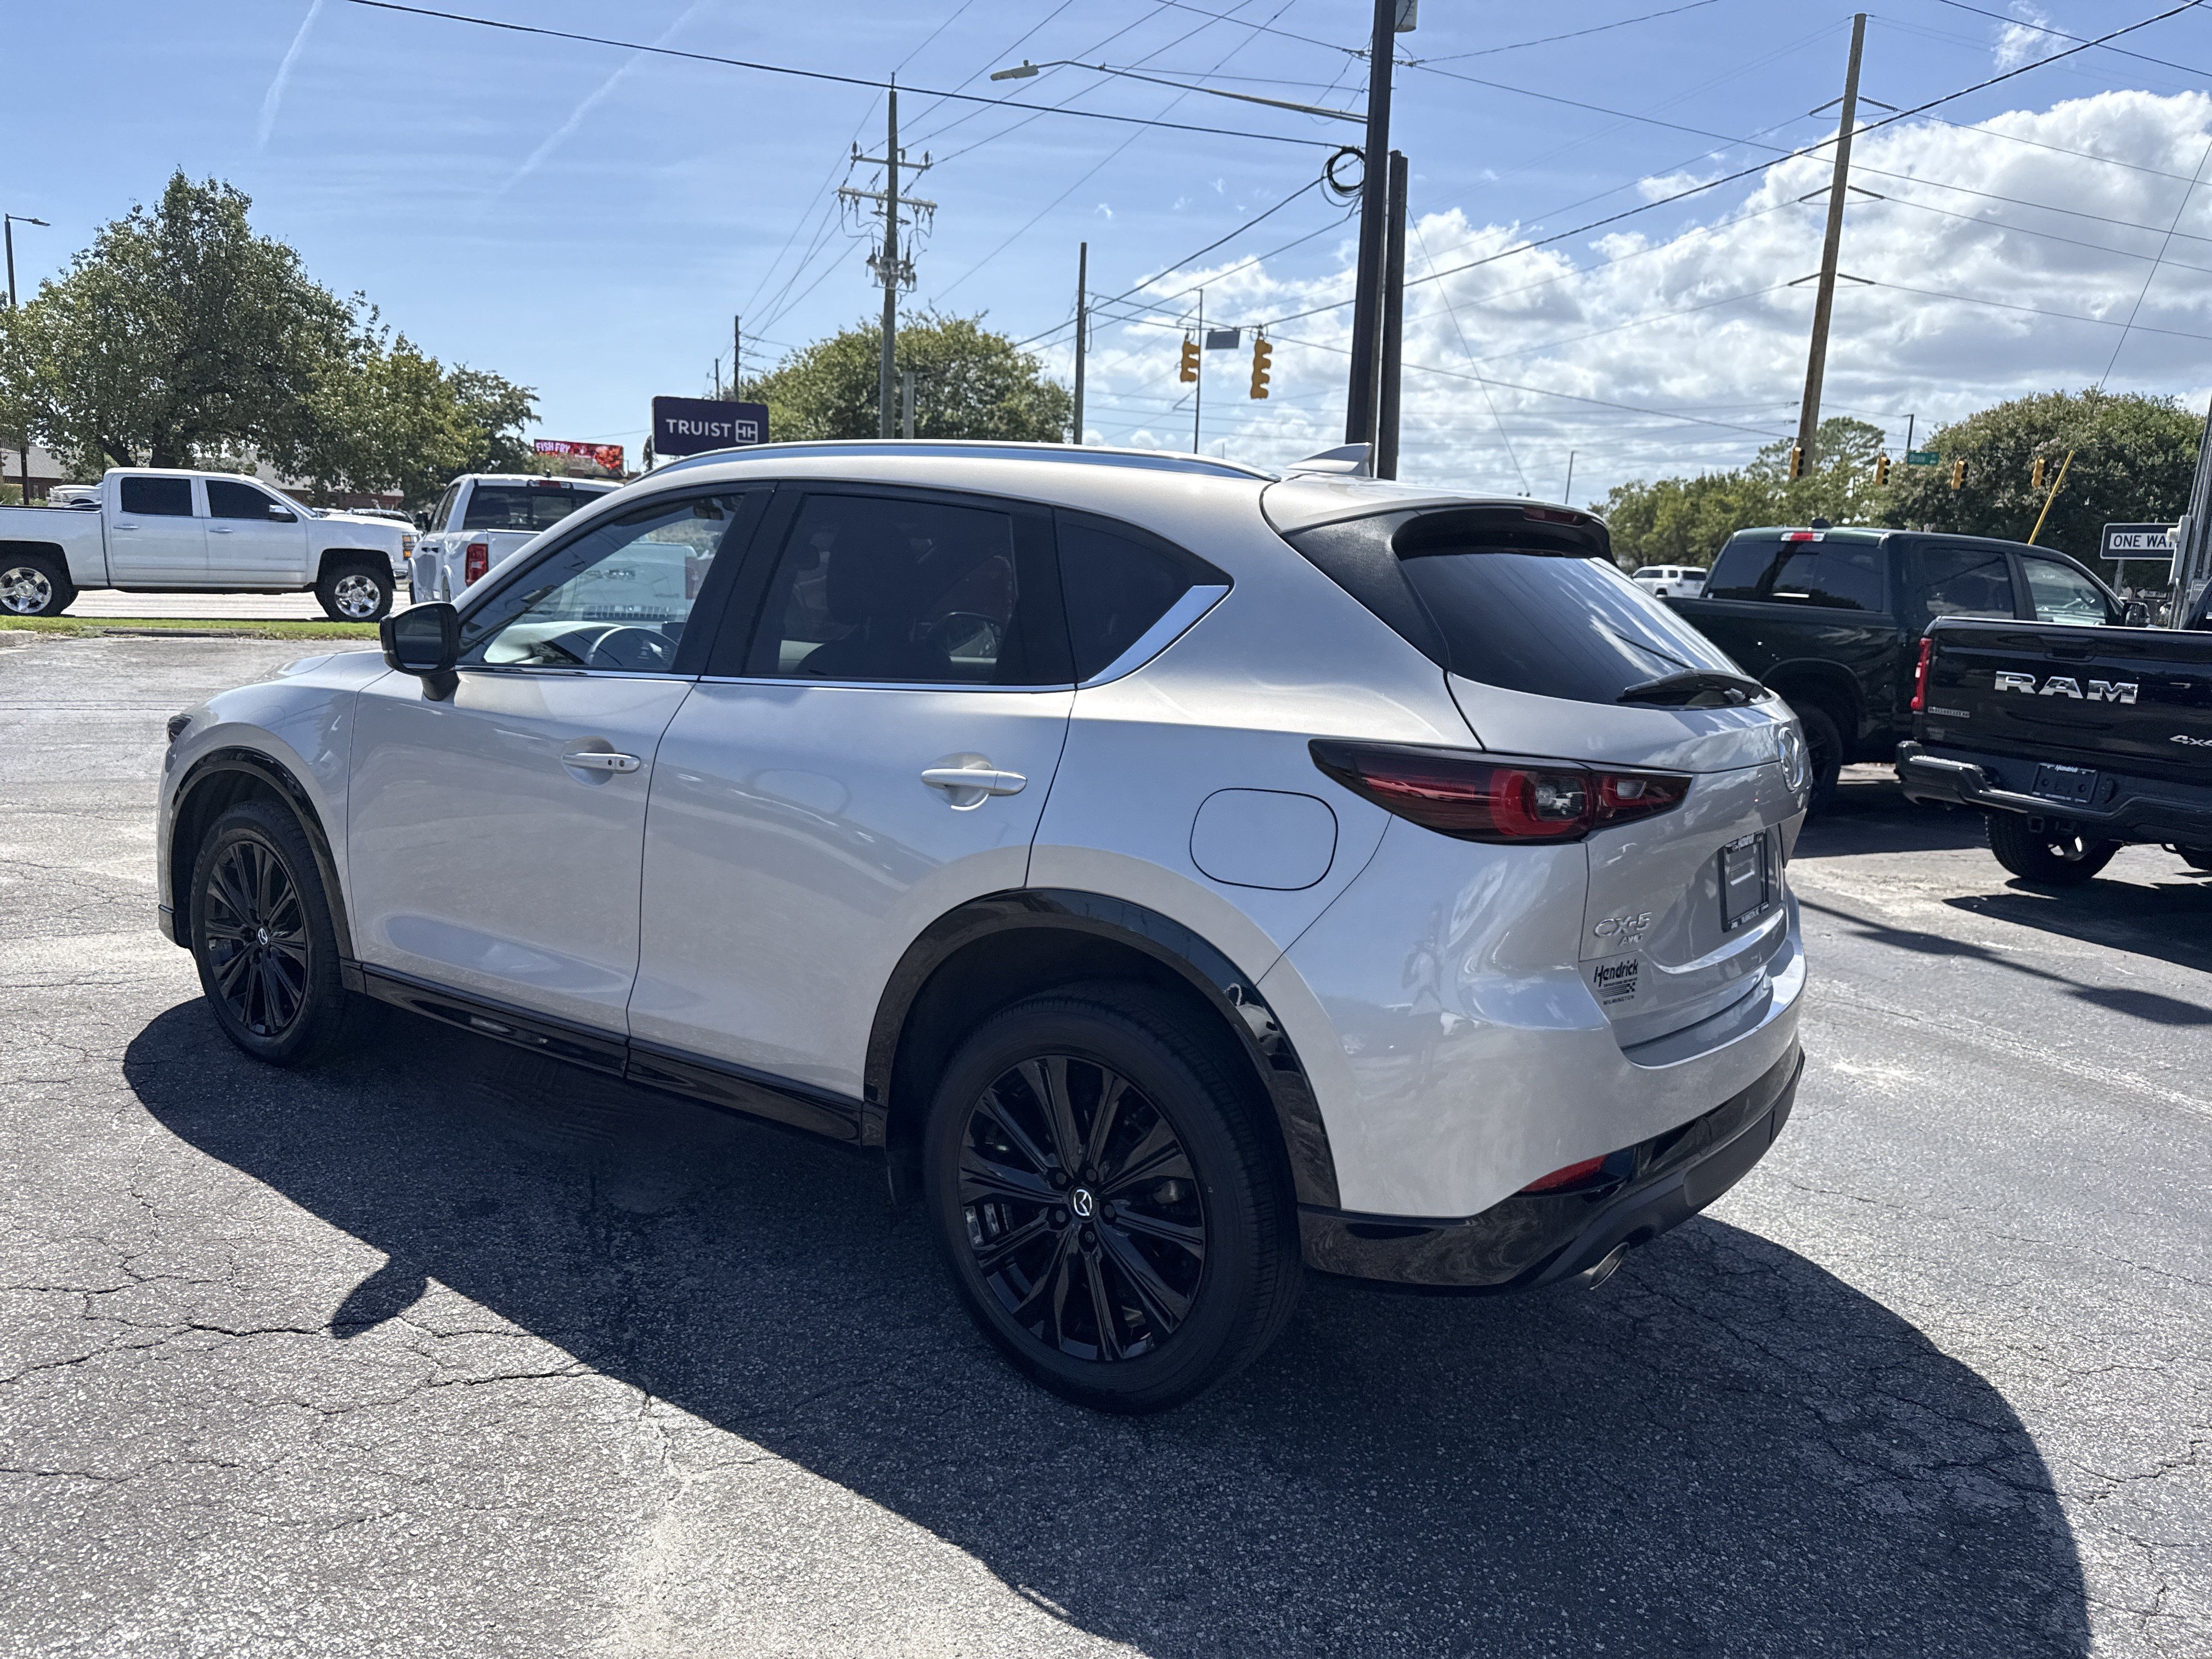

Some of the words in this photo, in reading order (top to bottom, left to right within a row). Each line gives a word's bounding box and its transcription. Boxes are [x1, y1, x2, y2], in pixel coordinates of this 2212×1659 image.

[665, 419, 732, 438] TRUIST
[535, 441, 554, 452] FISH
[555, 442, 571, 454] FRY
[2113, 535, 2142, 548] ONE
[1994, 670, 2139, 704] RAM
[1593, 912, 1652, 938] CX-5
[1593, 958, 1639, 988] Hendrick
